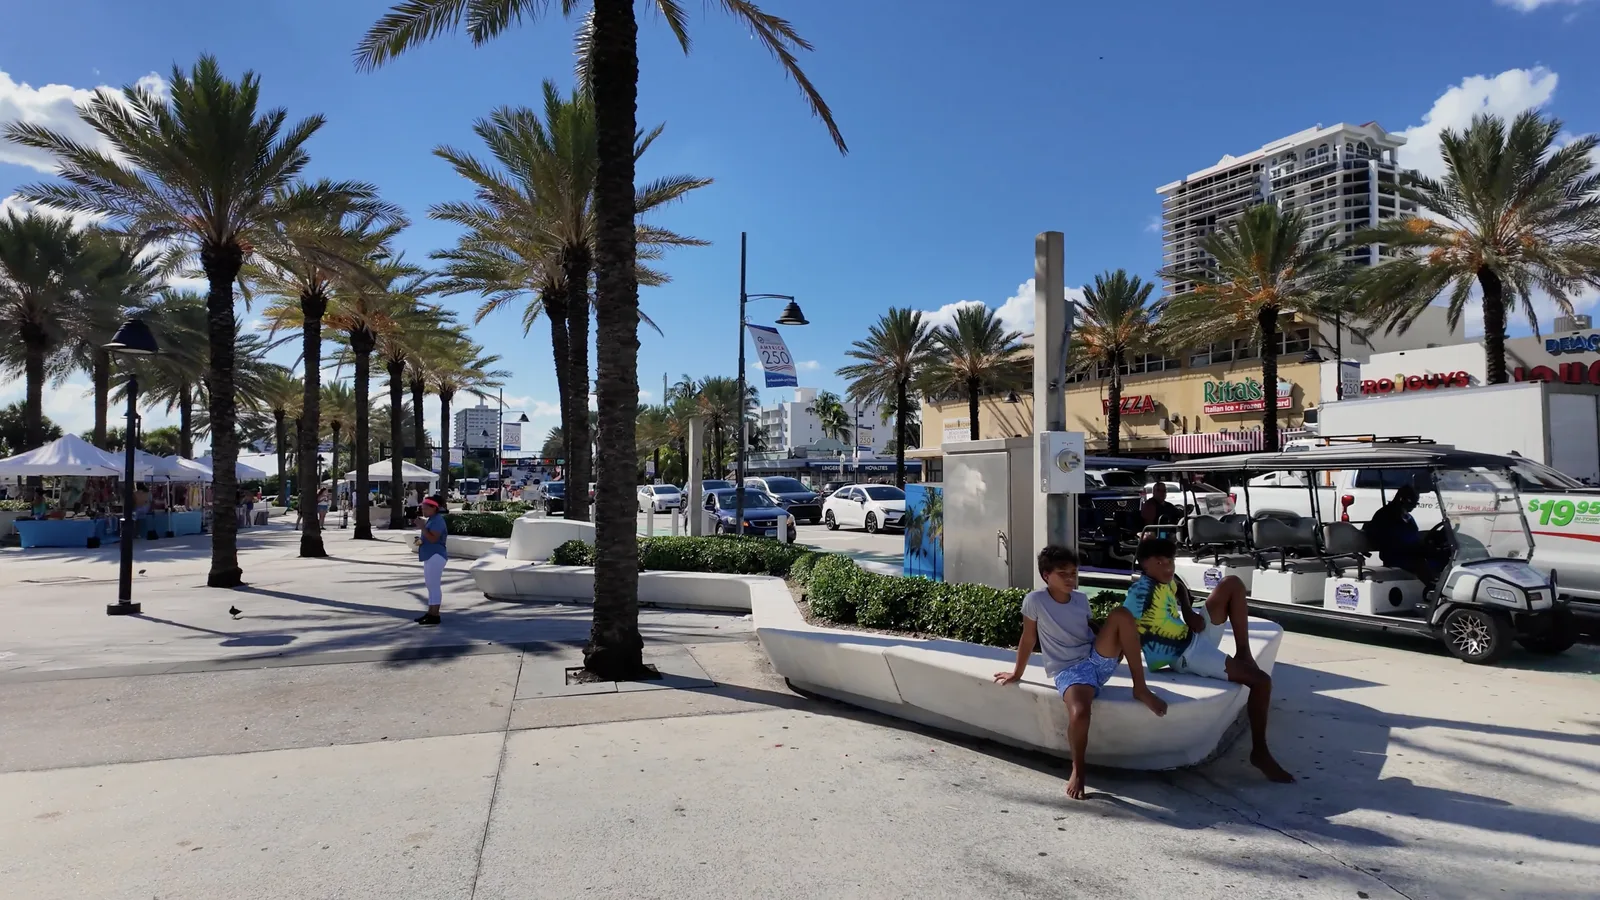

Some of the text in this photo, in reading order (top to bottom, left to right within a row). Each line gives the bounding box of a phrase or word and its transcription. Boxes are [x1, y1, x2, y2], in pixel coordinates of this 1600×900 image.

[762, 351, 790, 365] 250
[1204, 376, 1261, 404] Rita's
[1344, 383, 1359, 395] 250
[1405, 371, 1470, 391] GUYS
[1102, 395, 1155, 416] PZZA
